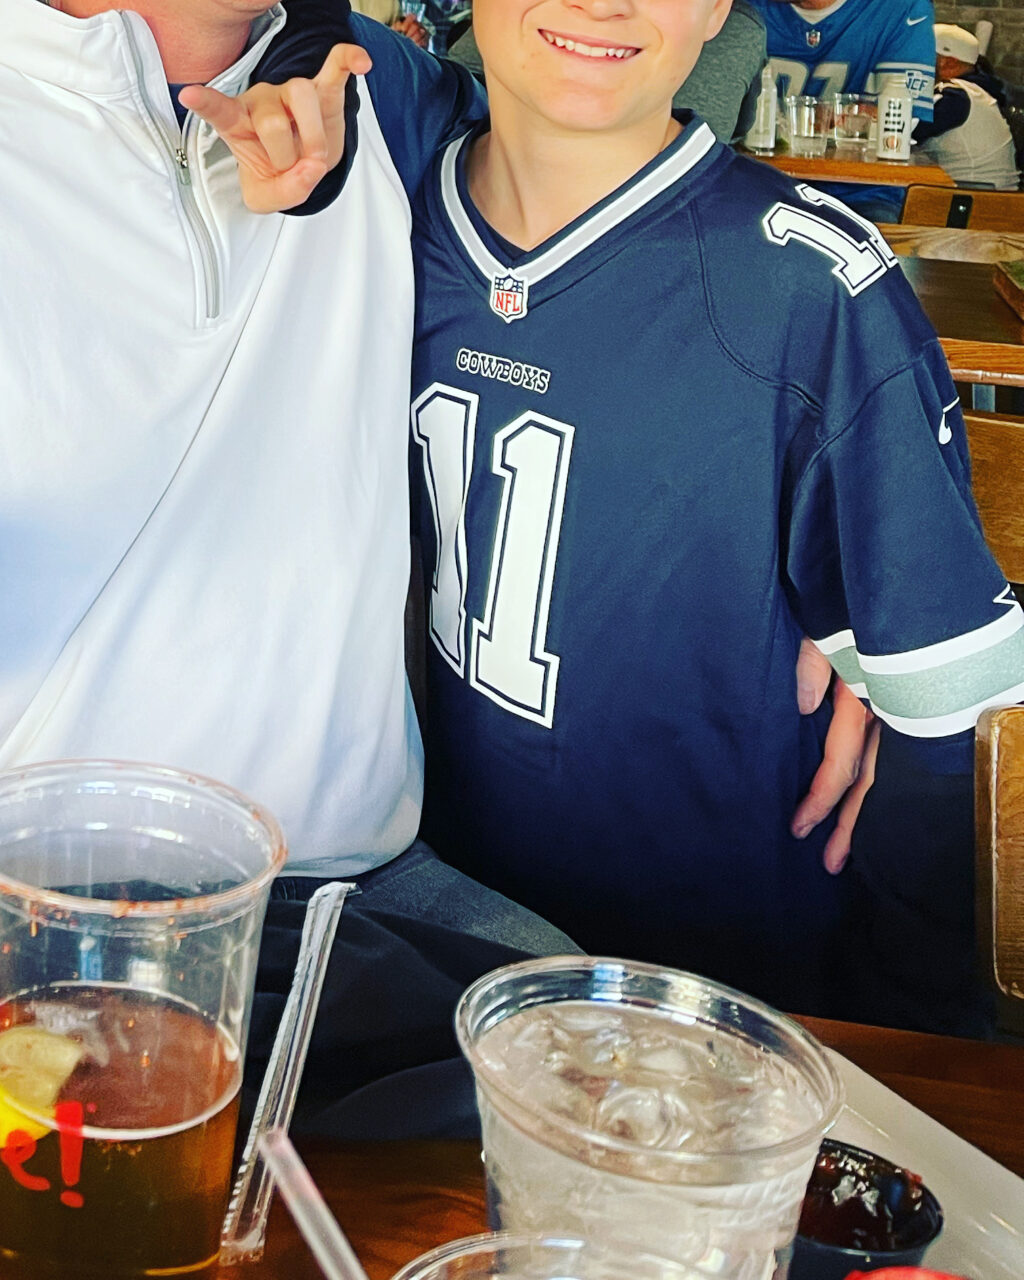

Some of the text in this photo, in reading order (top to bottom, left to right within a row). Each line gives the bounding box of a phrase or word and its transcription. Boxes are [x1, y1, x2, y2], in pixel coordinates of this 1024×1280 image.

[495, 291, 521, 314] NFL
[456, 347, 551, 395] COWBOYS
[410, 381, 576, 729] 11
